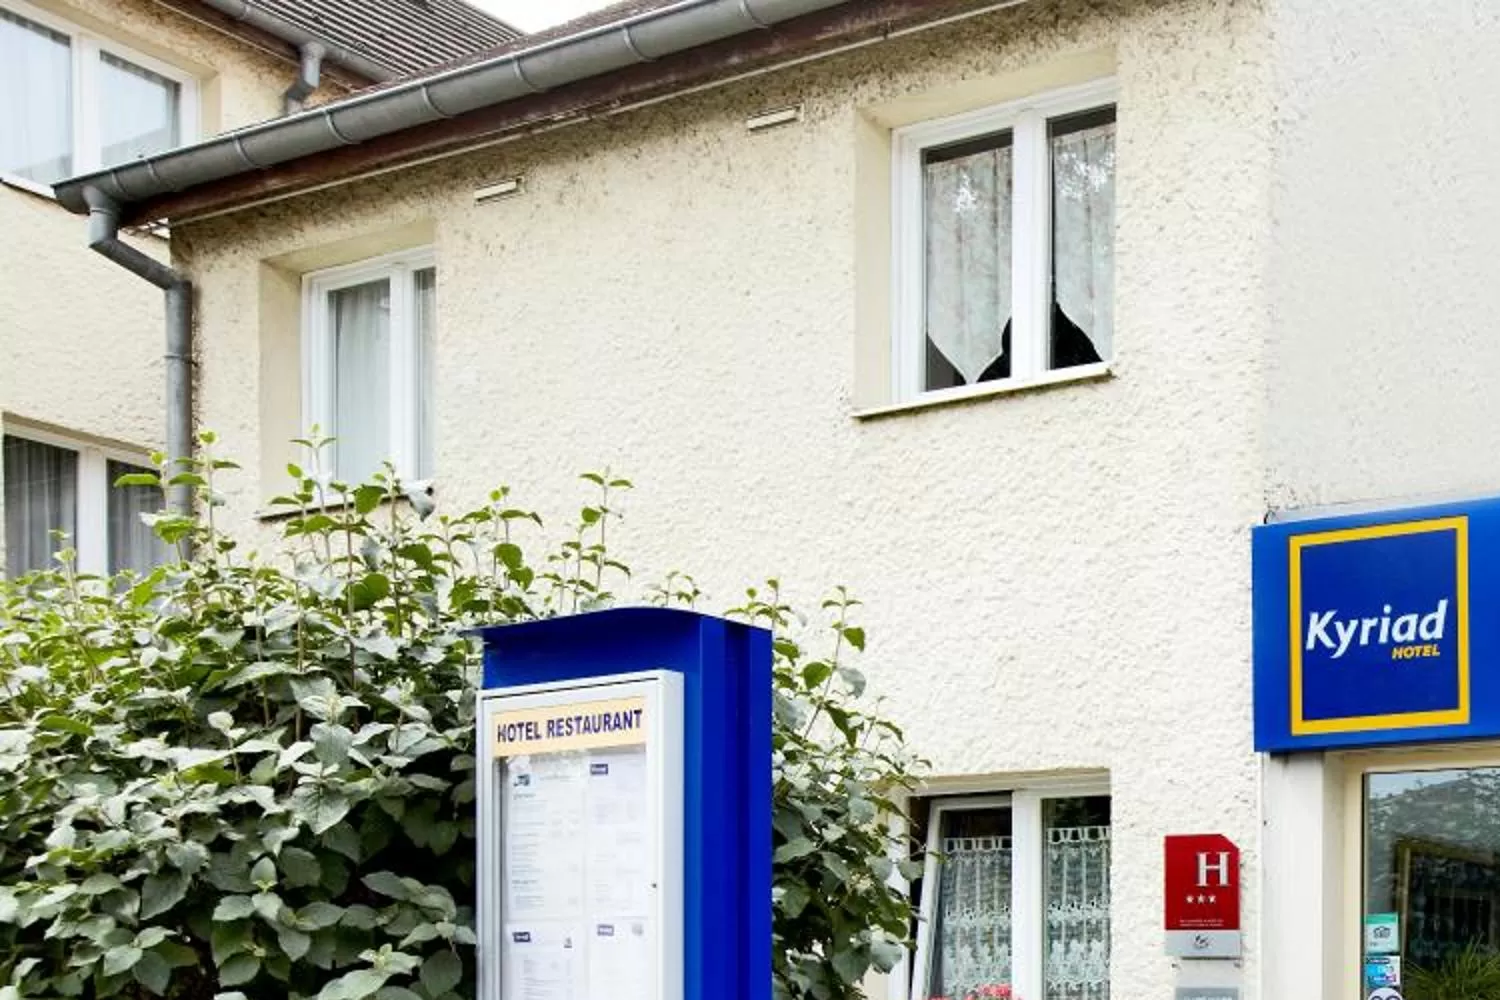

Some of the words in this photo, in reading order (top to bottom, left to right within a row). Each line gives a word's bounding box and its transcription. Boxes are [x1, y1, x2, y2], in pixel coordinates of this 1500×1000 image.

[1305, 597, 1448, 659] Kyriad
[1391, 644, 1441, 660] HOTEL
[497, 720, 541, 743] HOTEL
[546, 708, 643, 738] RESTAURANT
[1195, 851, 1231, 888] H
